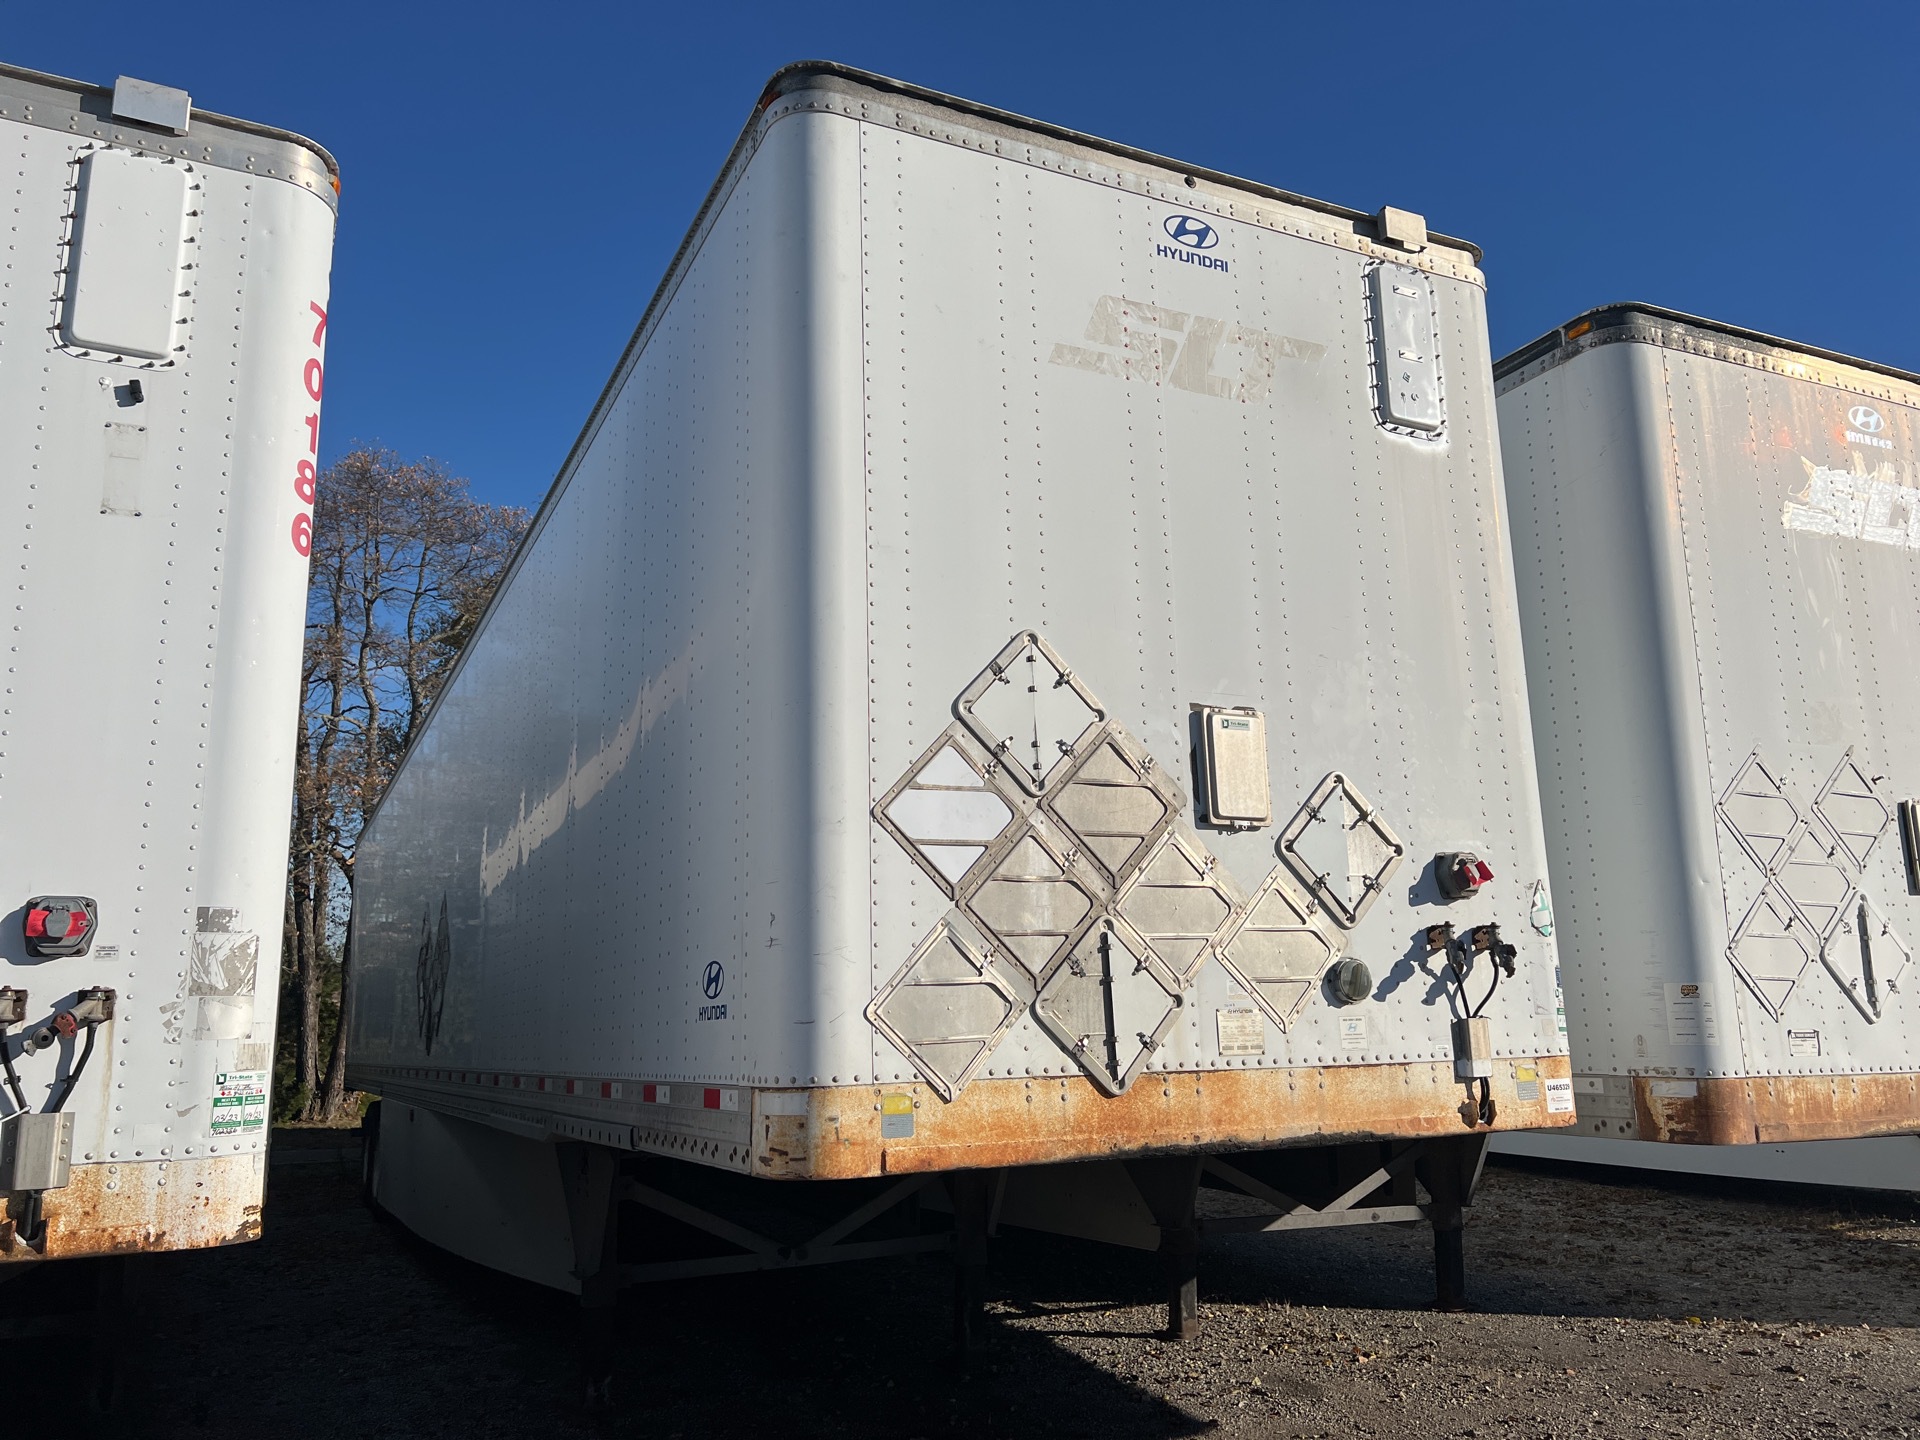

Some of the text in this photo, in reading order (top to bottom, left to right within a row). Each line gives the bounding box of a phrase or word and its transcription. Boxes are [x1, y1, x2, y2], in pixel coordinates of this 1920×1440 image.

[1156, 243, 1229, 273] HYUNDAI
[291, 301, 327, 557] 70186
[698, 1004, 727, 1021] HYUNDAI
